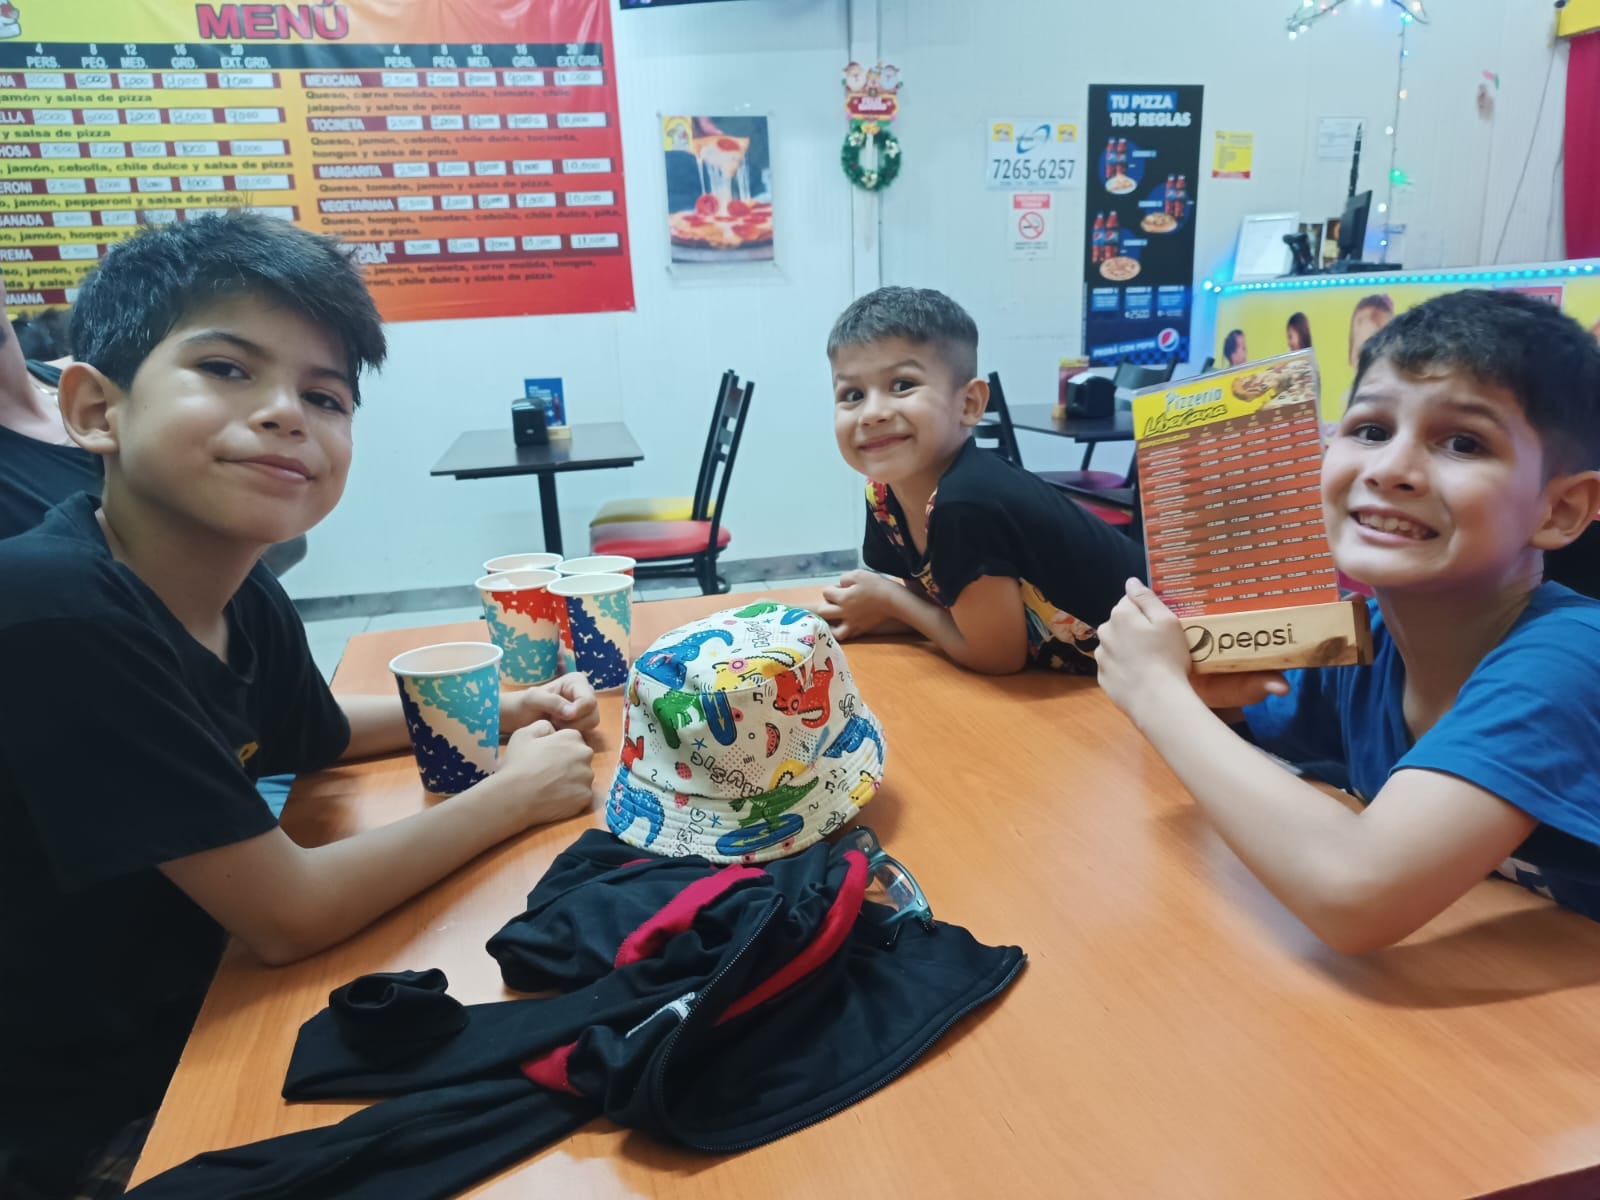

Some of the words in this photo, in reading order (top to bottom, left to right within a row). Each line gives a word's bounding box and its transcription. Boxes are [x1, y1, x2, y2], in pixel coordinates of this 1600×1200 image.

[124, 44, 137, 55] 12
[26, 56, 60, 69] PERS.
[120, 57, 148, 69] MED.
[305, 74, 362, 87] MEXICANA
[44, 95, 53, 104] y
[57, 94, 93, 102] salsa
[97, 93, 114, 102] de
[118, 93, 152, 104] pizza
[1110, 94, 1129, 110] TU
[1131, 94, 1174, 110] PIZZA
[376, 103, 409, 111] salsa
[412, 103, 427, 111] de
[311, 117, 366, 131] TOCINETA
[1110, 112, 1136, 127] TUS
[1138, 112, 1191, 127] REGLAS
[2, 131, 10, 140] y
[14, 128, 51, 138] salsa
[55, 128, 72, 138] de
[77, 128, 111, 139] pizza
[373, 148, 404, 157] salsa
[409, 148, 422, 156] de
[7, 164, 54, 174] jamón,
[58, 162, 112, 173] cebolla,
[116, 161, 148, 171] chile
[152, 160, 188, 170] dulce
[193, 163, 200, 172] y
[204, 161, 238, 170] salsa
[242, 160, 257, 169] de
[261, 160, 293, 170] pizza
[993, 159, 1076, 180] 7265-6257
[468, 182, 498, 190] salsa
[502, 181, 516, 189] de
[14, 198, 60, 208] jamón,
[65, 197, 132, 207] pepperoni
[148, 195, 182, 204] salsa
[186, 194, 202, 203] de
[20, 231, 66, 242] jamón,
[69, 230, 118, 240] hongos
[370, 228, 384, 236] de
[1218, 623, 1294, 655] pepsi
[672, 807, 707, 857] USIC
